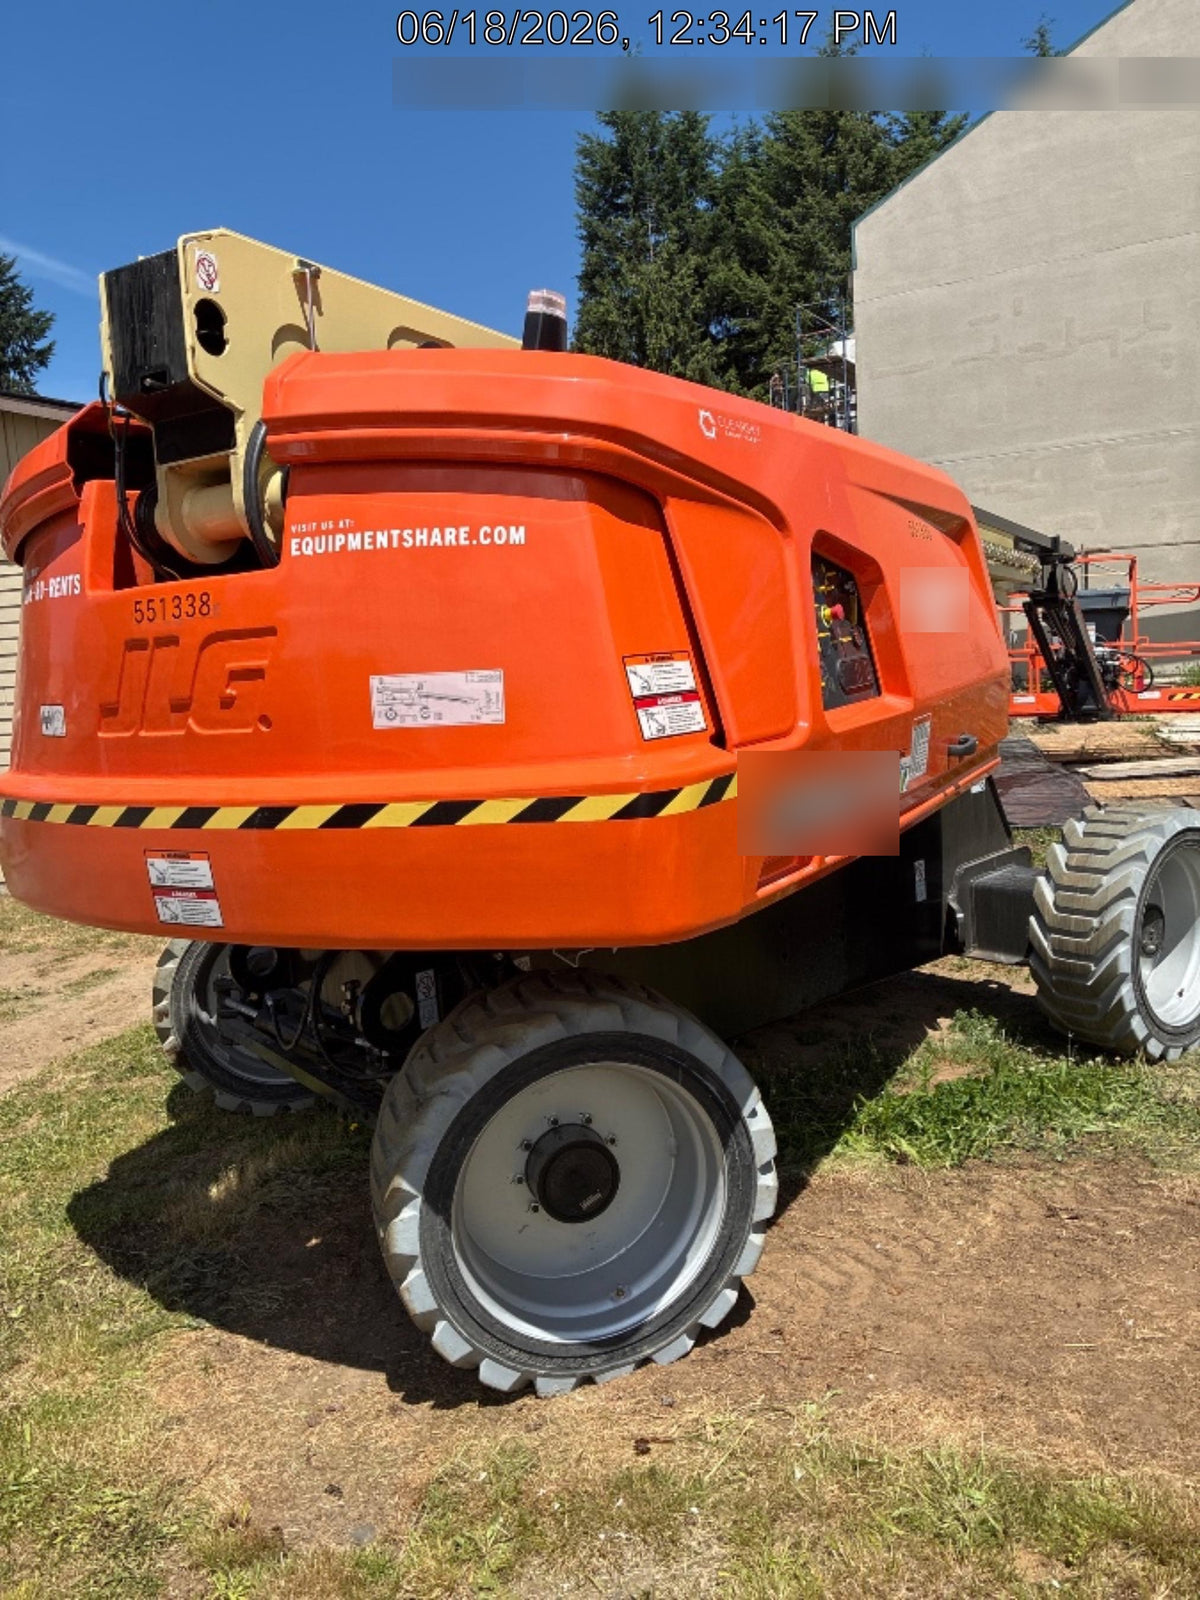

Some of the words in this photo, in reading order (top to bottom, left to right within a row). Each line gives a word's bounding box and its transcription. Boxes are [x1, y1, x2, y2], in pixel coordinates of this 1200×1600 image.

[290, 525, 527, 557] EQUIPMENTSHARE.COM
[291, 522, 316, 533] VISIT
[321, 520, 334, 530] US
[133, 591, 211, 625] 551338
